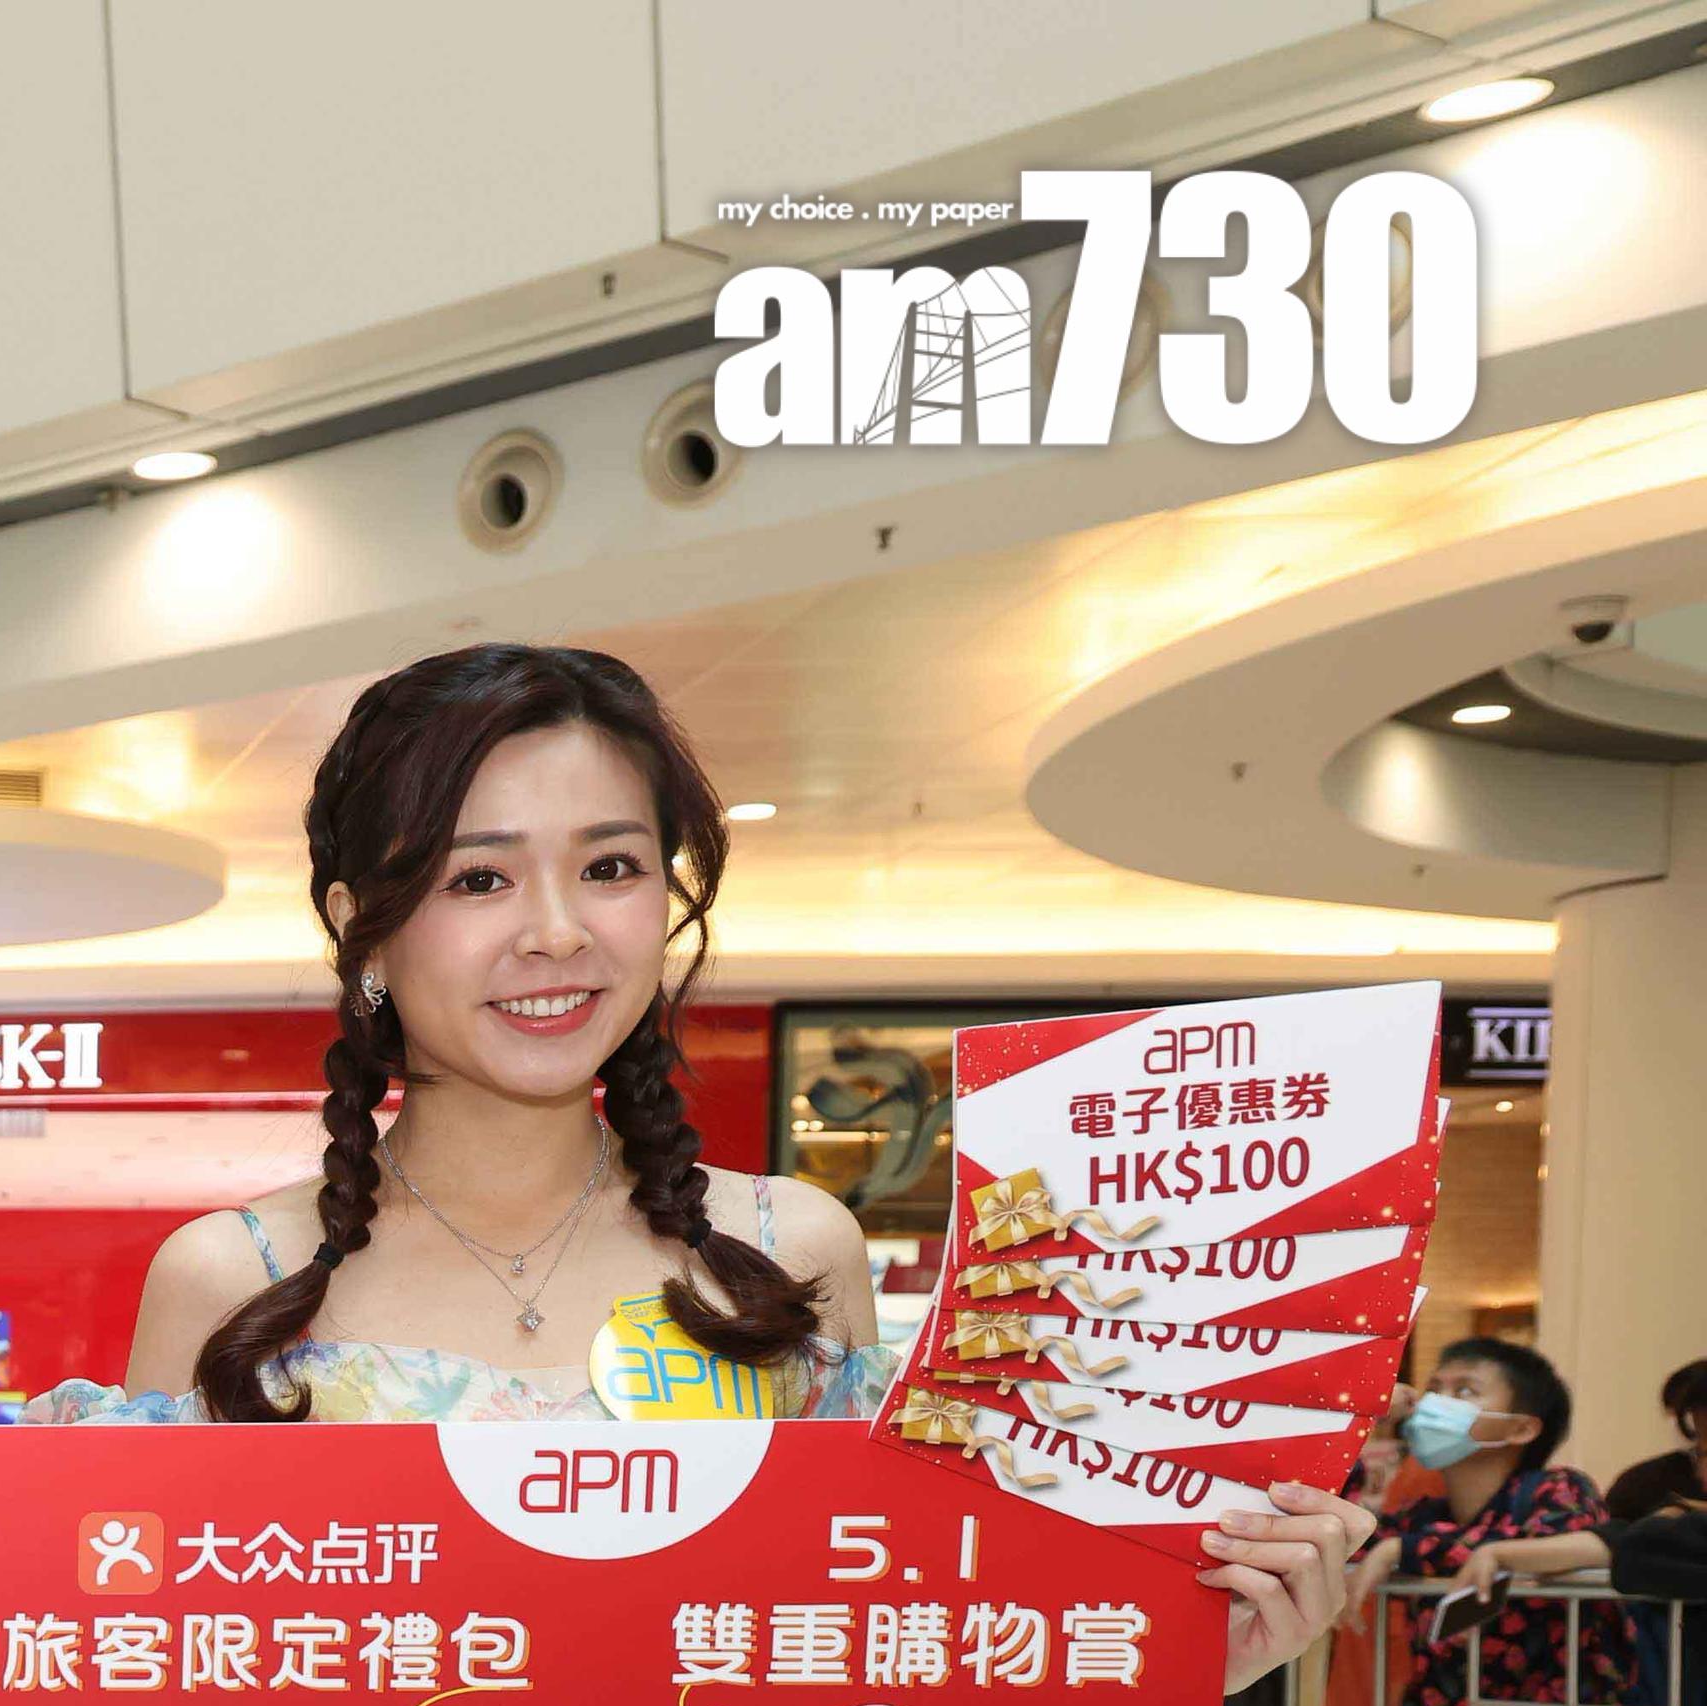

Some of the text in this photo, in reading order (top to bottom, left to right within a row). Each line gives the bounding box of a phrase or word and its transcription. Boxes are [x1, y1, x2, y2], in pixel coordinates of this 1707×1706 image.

[1144, 1021, 1256, 1075] apm
[1069, 1072, 1331, 1138] 電子優惠券
[1089, 1136, 1311, 1205] HK$100
[518, 1449, 679, 1514] apm
[175, 1521, 439, 1584] 大众点评
[2, 1612, 533, 1692] 旅客限定禮包
[671, 1601, 1154, 1689] 雙重購物賞
